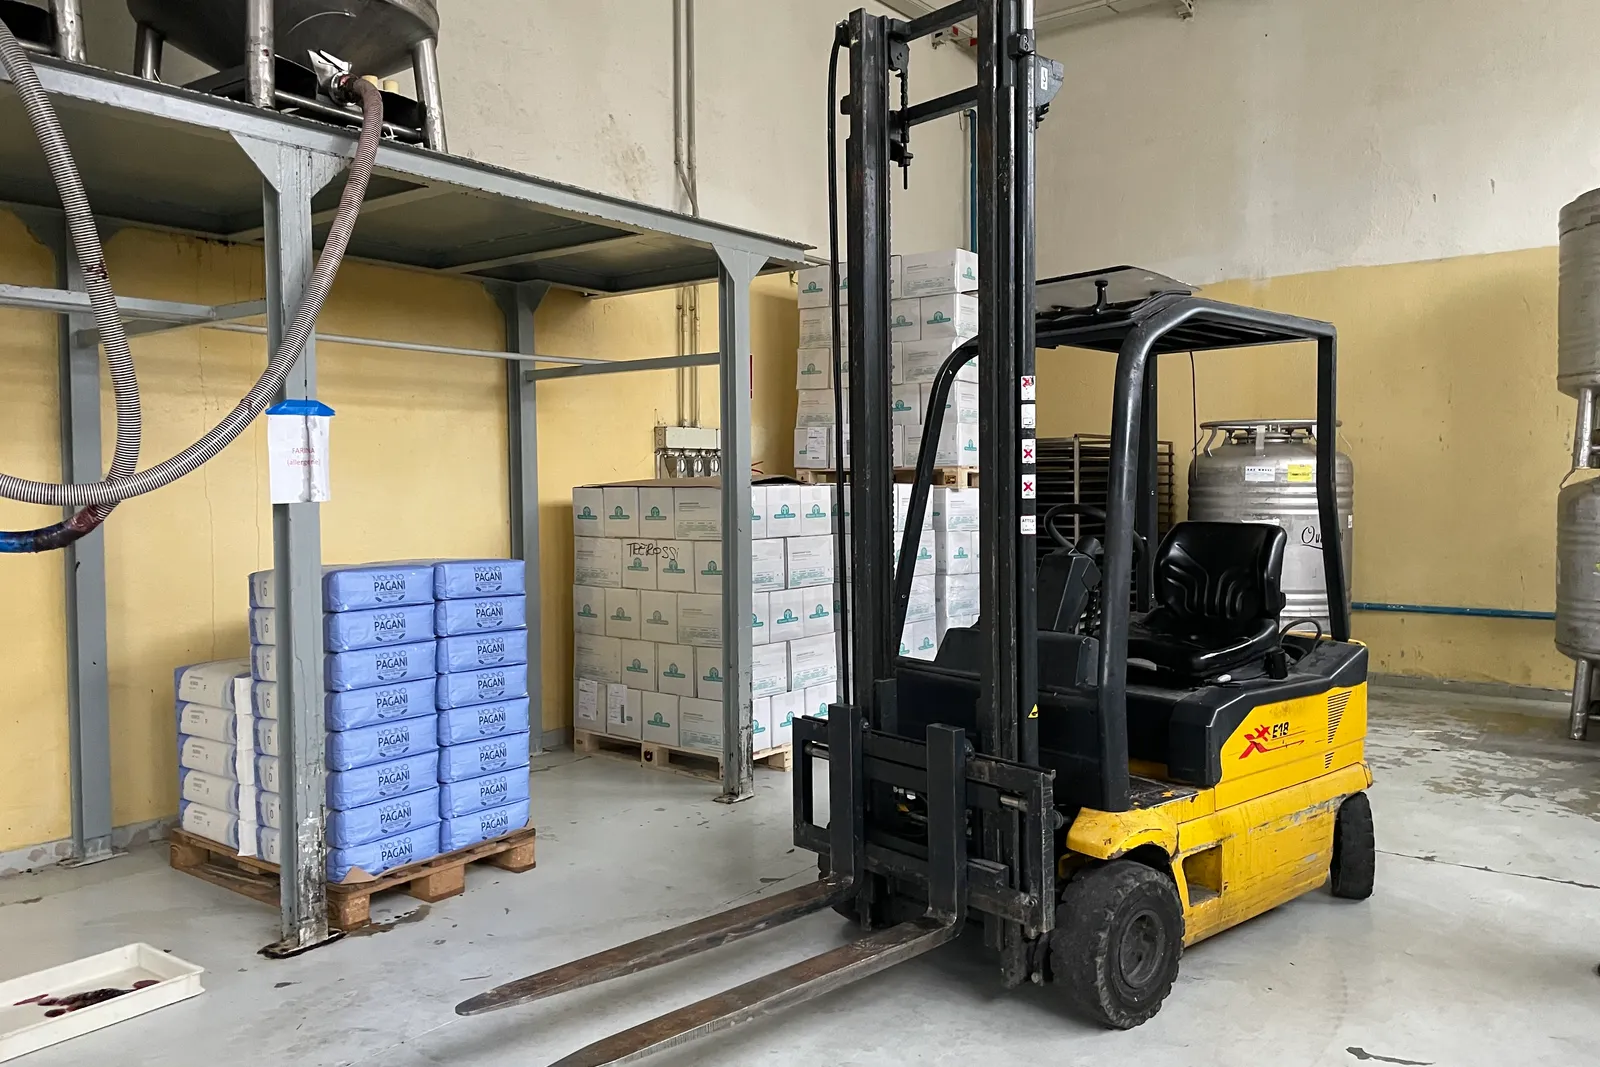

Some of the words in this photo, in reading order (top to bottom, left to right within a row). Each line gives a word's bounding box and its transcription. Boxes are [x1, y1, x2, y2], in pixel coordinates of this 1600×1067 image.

[475, 573, 502, 582] PAGANI
[374, 581, 405, 592] PAGANI
[476, 608, 503, 618] PAGANI
[375, 619, 406, 631] PAGANI
[477, 644, 504, 654] PAGANI
[377, 657, 408, 670] PAGANI
[478, 678, 505, 689] PAGANI
[377, 694, 408, 708] PAGANI
[479, 714, 506, 725] PAGANI
[1272, 721, 1289, 738] E18
[378, 732, 409, 747] PAGANI
[480, 749, 507, 761] PAGANI
[378, 770, 410, 786] PAGANI
[480, 783, 507, 796] PAGANI
[381, 807, 412, 823] PAGANI
[481, 816, 508, 831] PAGANI
[381, 843, 413, 861] PAGANI
